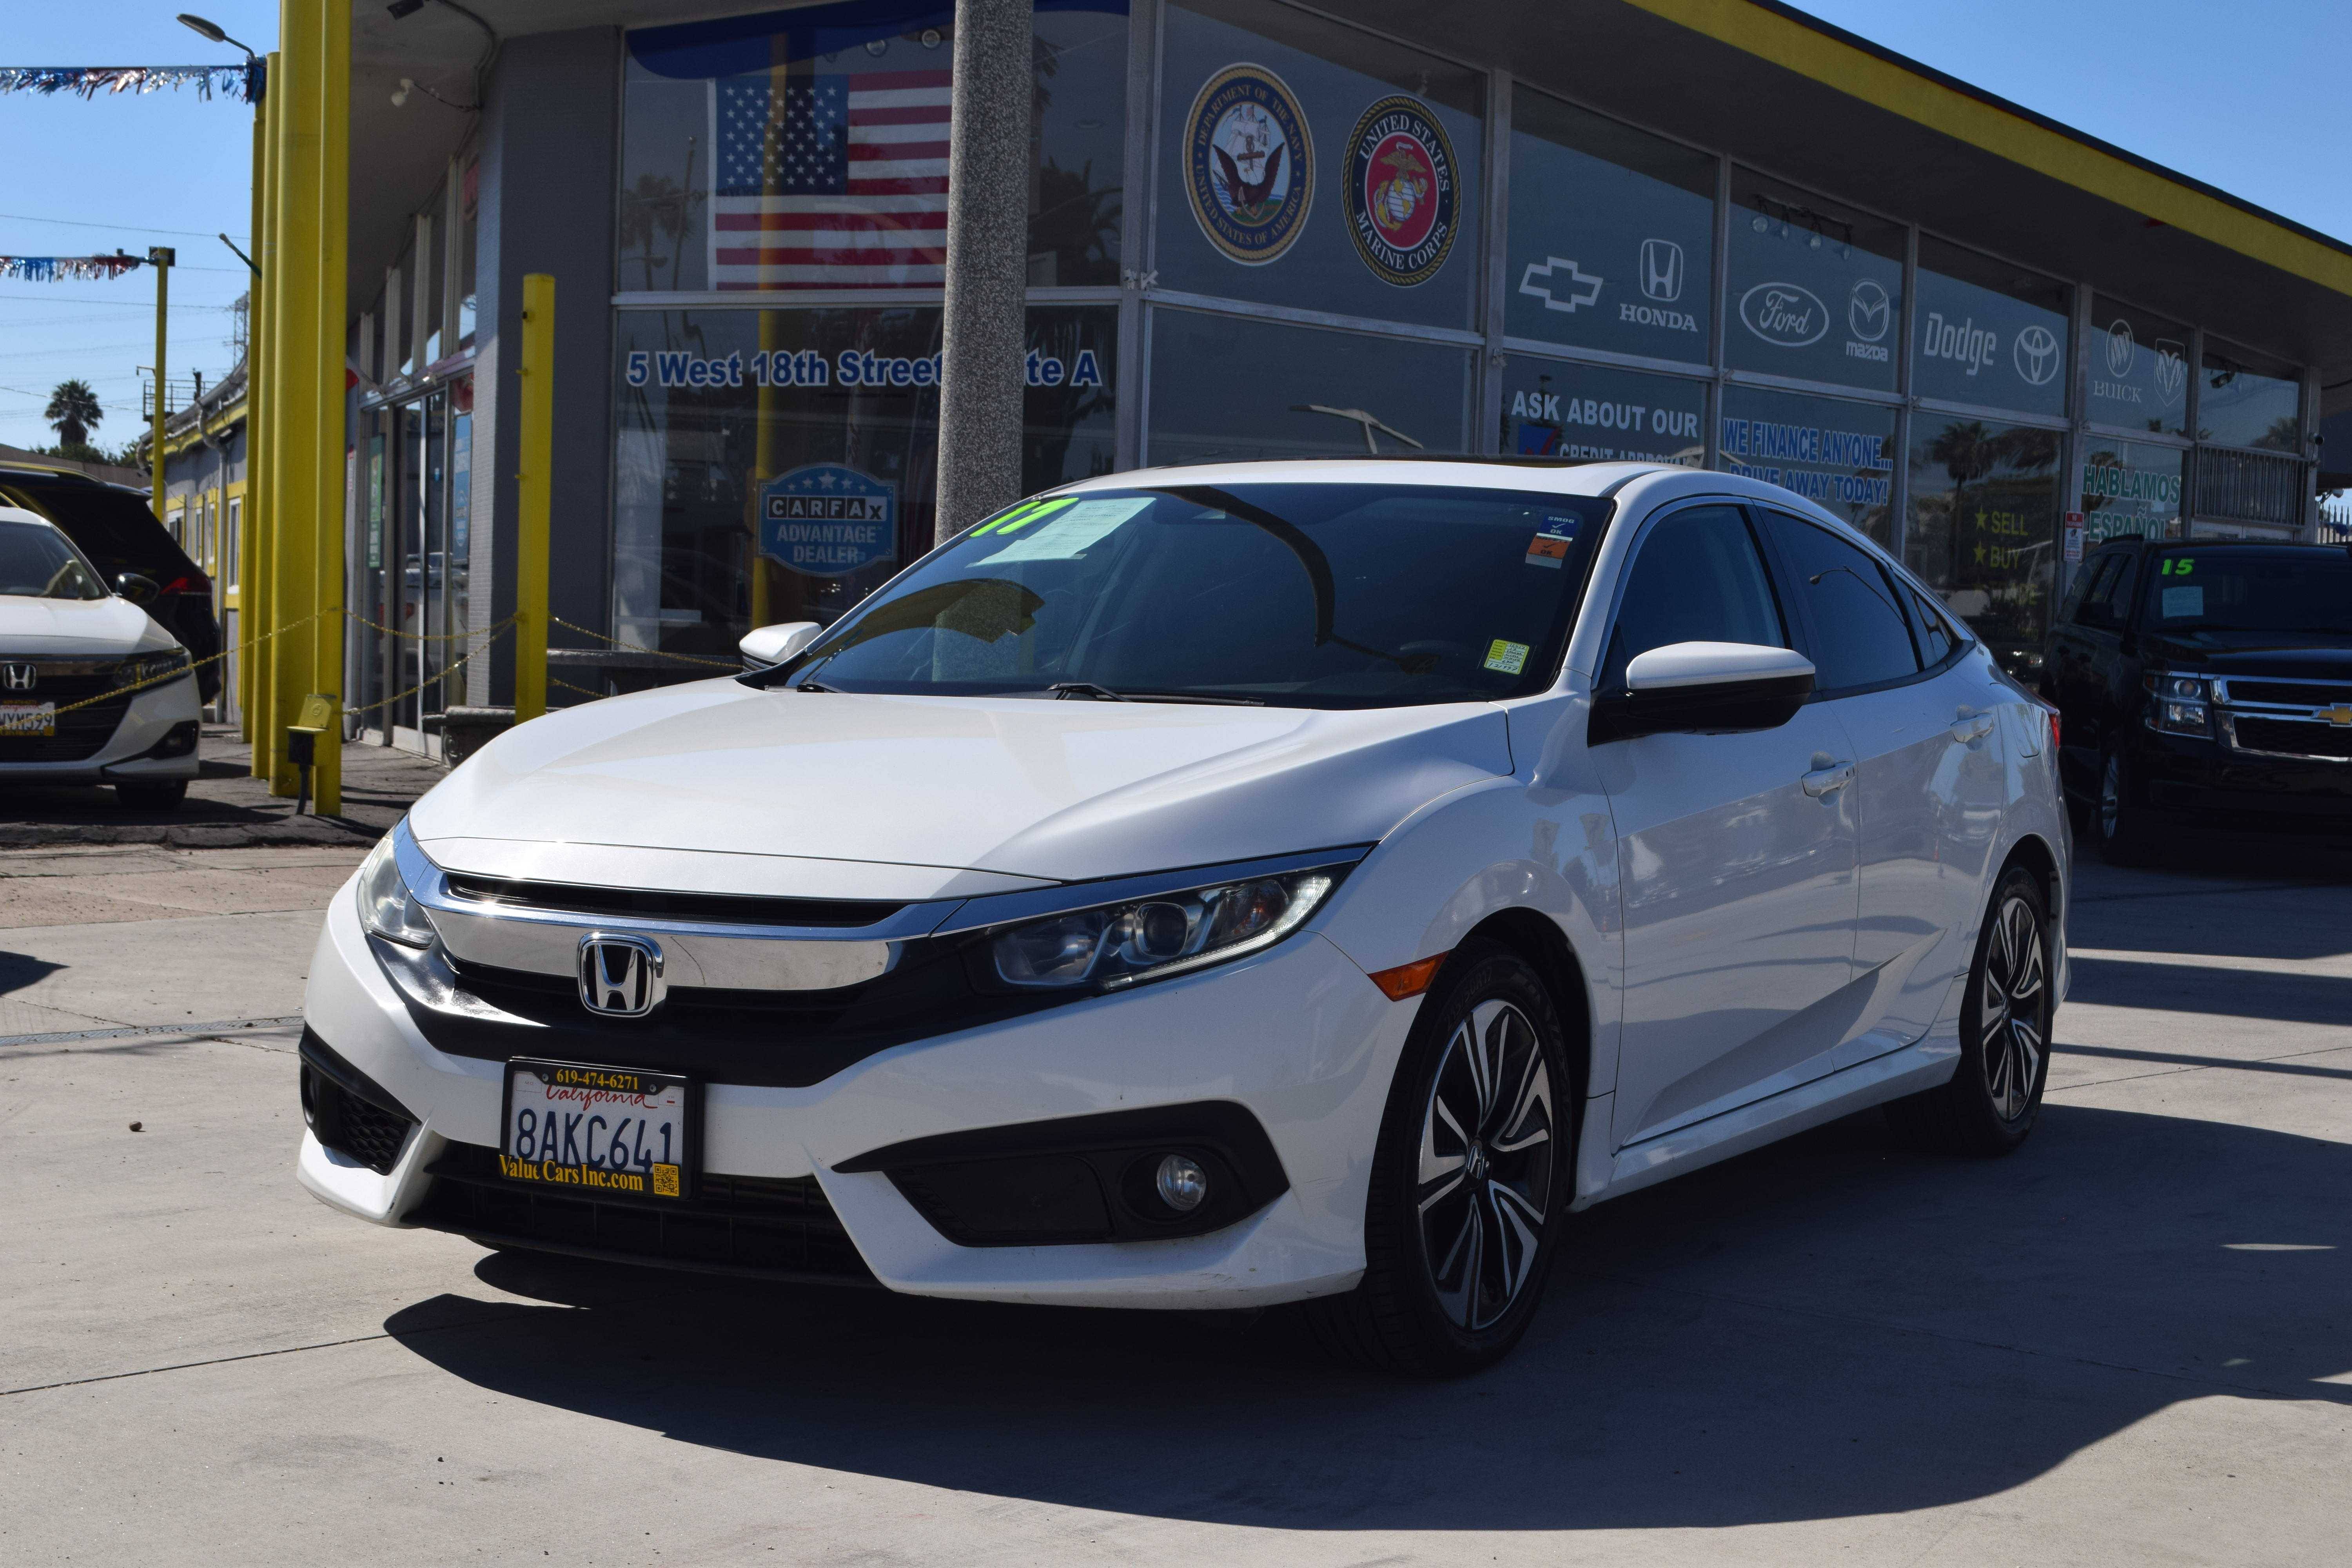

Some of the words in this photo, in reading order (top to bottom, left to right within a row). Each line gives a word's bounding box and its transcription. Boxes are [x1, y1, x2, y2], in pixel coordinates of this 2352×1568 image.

[1198, 84, 1251, 146] DEPARTMENT
[1255, 87, 1269, 102] OF
[1272, 97, 1288, 125] THE
[1287, 123, 1303, 162] NAVY
[1359, 114, 1409, 160] UNITED
[1412, 120, 1450, 192] STATES
[1195, 164, 1218, 219] UNITED
[1216, 218, 1252, 245] STATES
[1254, 234, 1269, 245] OF
[1271, 186, 1301, 239] AMERICA
[1356, 210, 1404, 270] MARINE
[1408, 221, 1448, 269] CORPS
[1619, 303, 1698, 332] HONDA
[1759, 290, 1810, 334] Ford
[1923, 312, 1997, 376] Dodge
[626, 350, 650, 387] 5
[656, 348, 742, 387] West
[751, 349, 829, 387] 18th
[1069, 349, 1103, 386] A
[2094, 380, 2143, 403] BUICK
[1511, 390, 1560, 421] ASK
[1567, 398, 1645, 431] ABOUT
[1652, 409, 1698, 438] OUR
[1723, 417, 1749, 455] WE
[1751, 421, 1819, 463] FINANCE
[1784, 469, 1831, 499] AWAY
[1834, 474, 1889, 506] TODAY!
[2082, 464, 2181, 505] HABLAMOS
[769, 498, 883, 521] CARFAX
[969, 497, 1079, 538] 17
[1991, 510, 2029, 537] SELL
[777, 524, 877, 544] ADVANTAGE
[793, 545, 858, 564] DEALER
[1989, 545, 2020, 571] BUY
[2161, 558, 2196, 576] 15
[546, 1085, 658, 1111] California
[556, 1068, 639, 1090] 619-474-6271
[515, 1108, 671, 1174] 8AKC641
[543, 1160, 579, 1184] Cars
